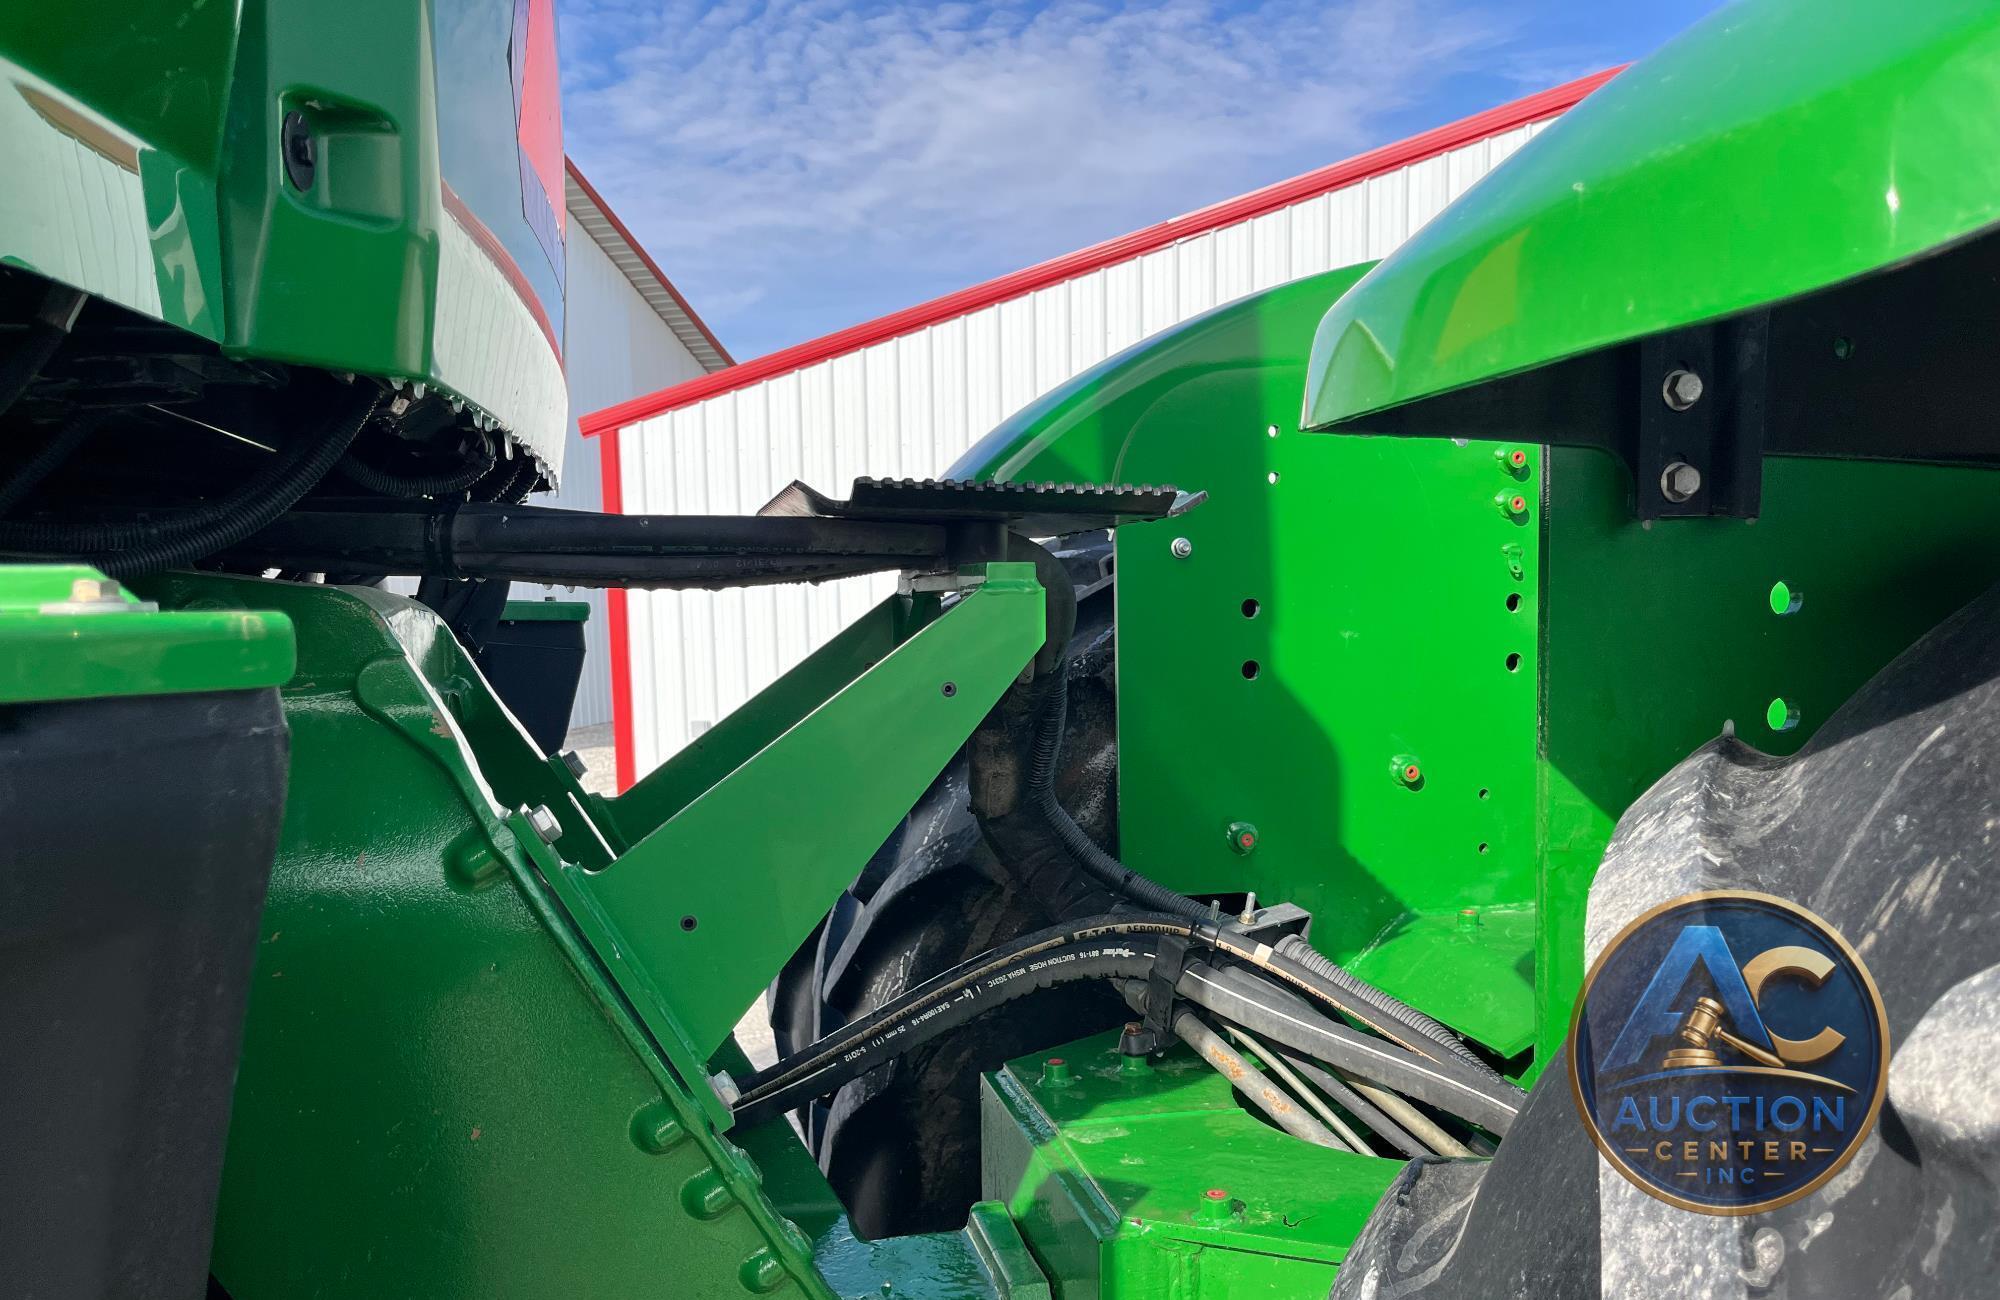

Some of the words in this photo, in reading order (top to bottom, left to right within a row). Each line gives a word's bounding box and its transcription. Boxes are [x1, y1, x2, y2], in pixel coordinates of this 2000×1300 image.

[1102, 948, 1136, 958] Parker
[1029, 959, 1048, 973] HOSE
[1047, 953, 1076, 968] SUCTION
[1006, 967, 1027, 982] MSHA
